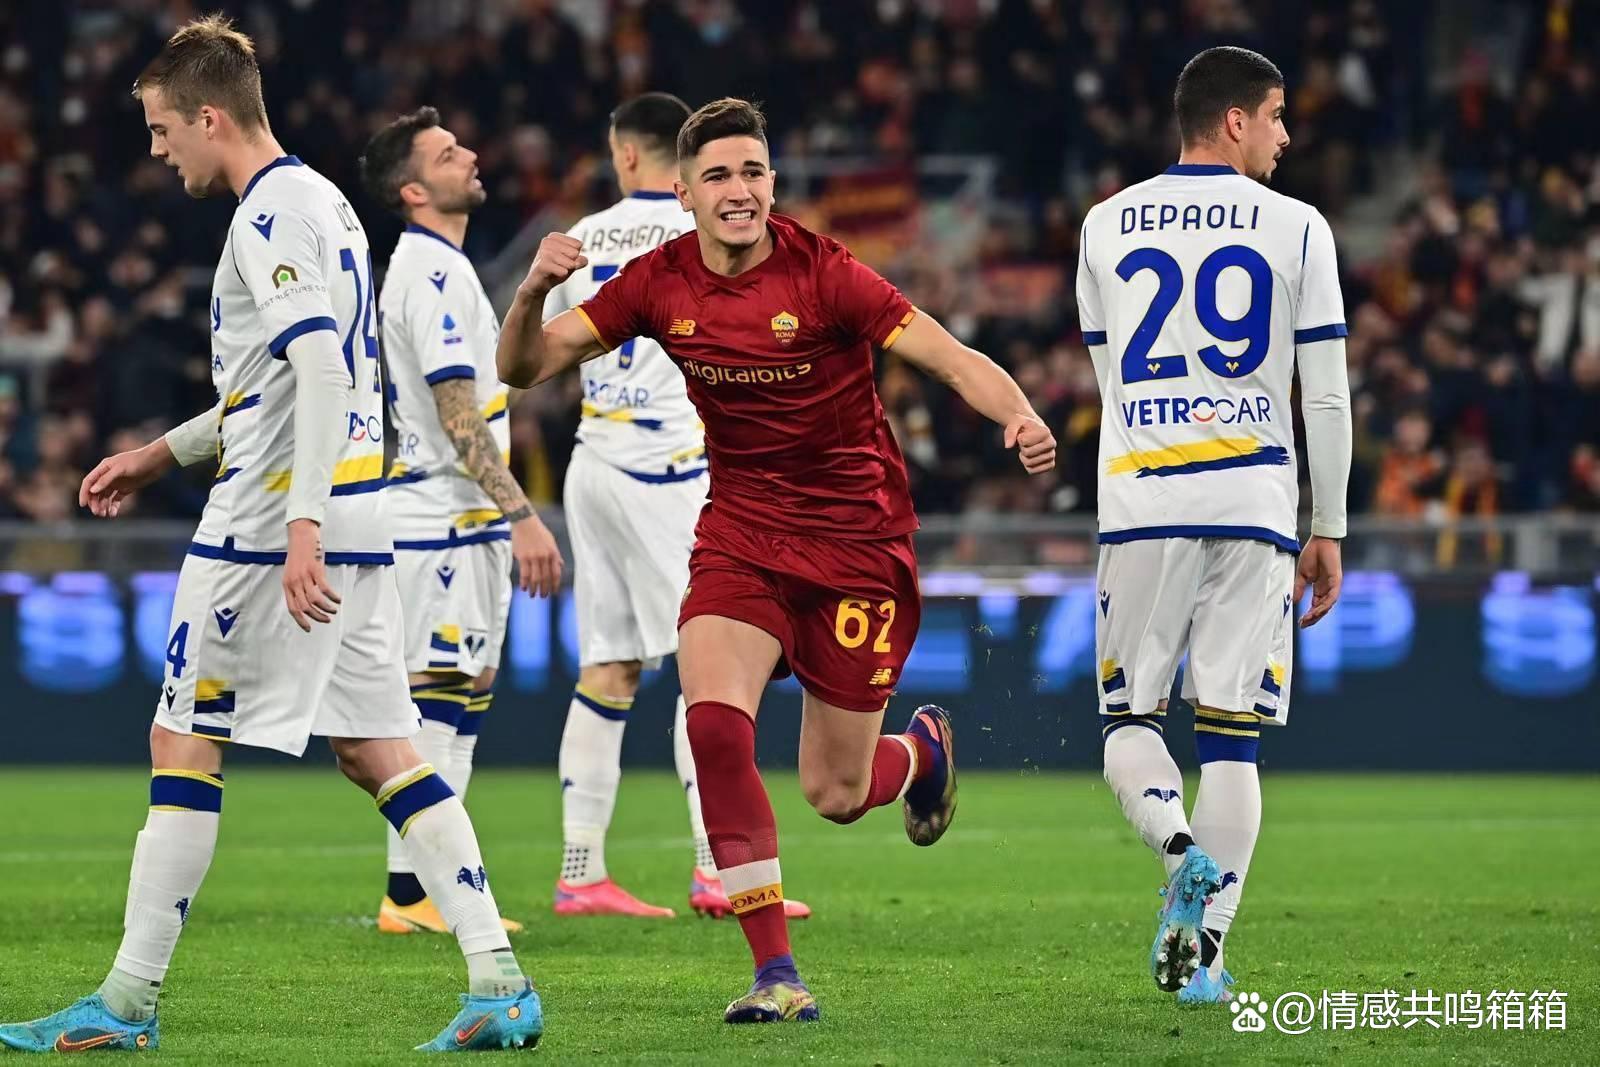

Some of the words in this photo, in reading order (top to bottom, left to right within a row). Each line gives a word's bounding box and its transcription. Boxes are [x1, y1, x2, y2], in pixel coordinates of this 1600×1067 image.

[1120, 204, 1259, 235] DEPAOLI
[1114, 244, 1273, 385] 29
[775, 331, 796, 339] ROMA
[683, 360, 812, 386] digitalbits
[1122, 396, 1271, 428] VETROCAR
[835, 597, 896, 653] 62
[166, 621, 190, 678] 4
